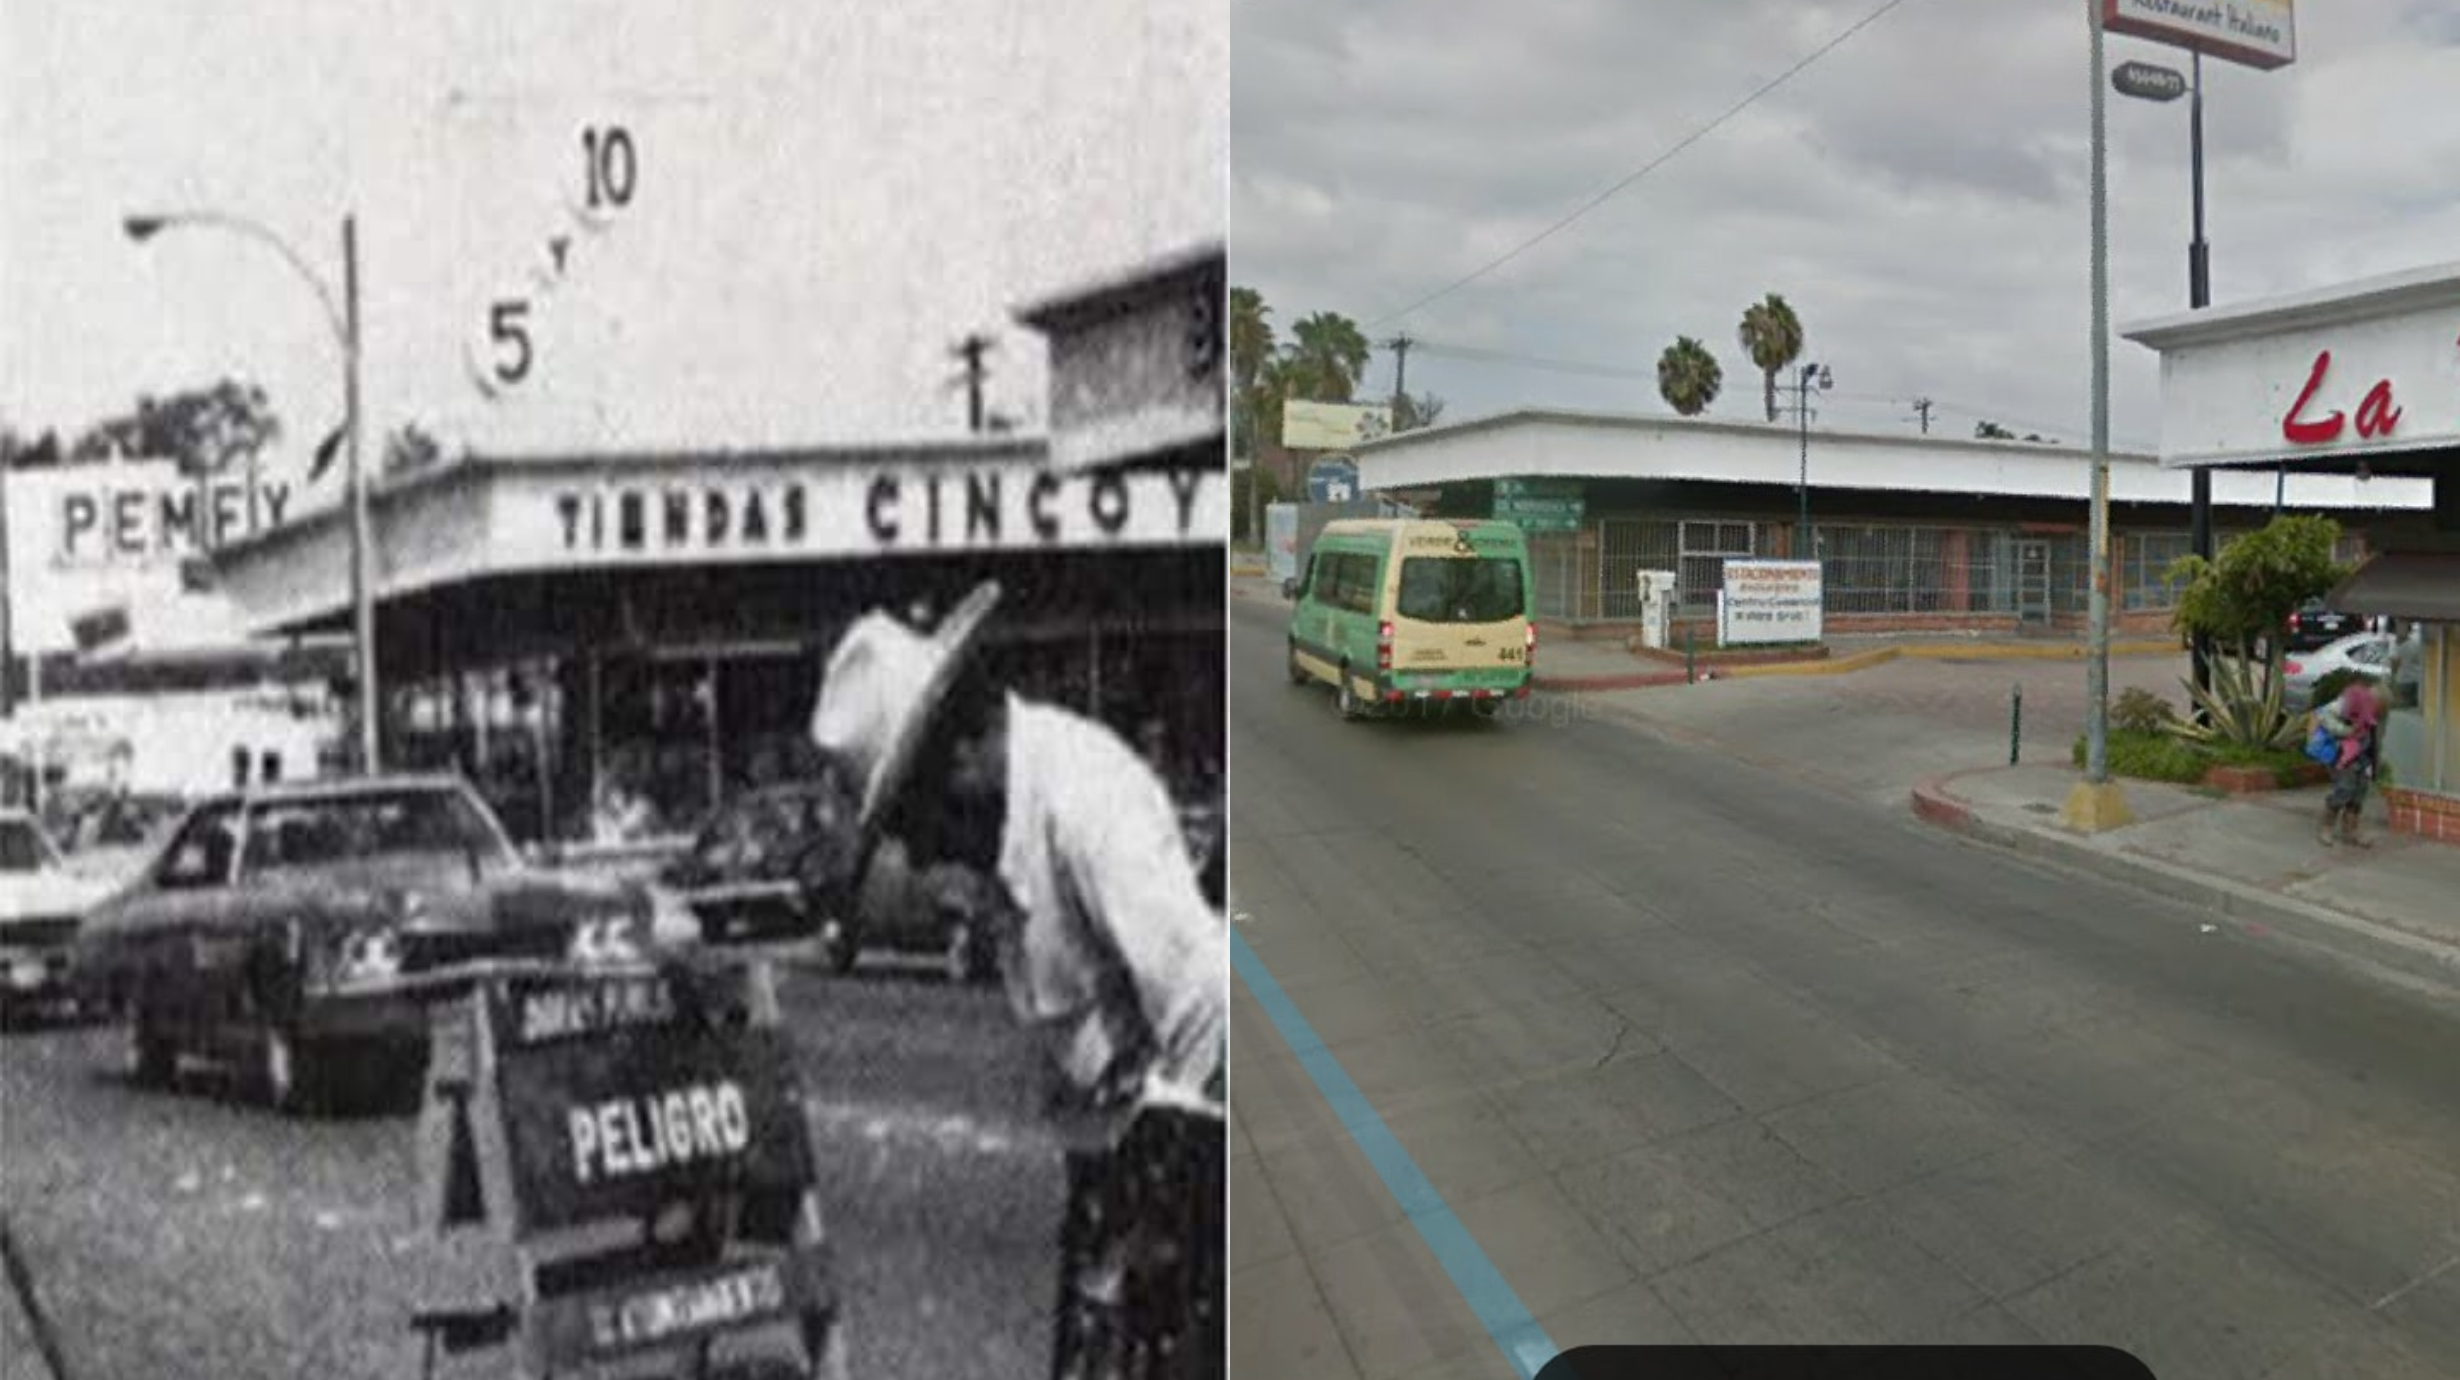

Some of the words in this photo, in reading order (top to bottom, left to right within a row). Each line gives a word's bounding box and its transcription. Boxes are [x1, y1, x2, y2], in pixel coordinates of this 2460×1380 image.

[583, 127, 637, 206] 10
[491, 302, 531, 382] 5
[2282, 350, 2402, 443] La
[867, 471, 1128, 543] CINCO
[569, 1082, 748, 1182] PELIGRO
